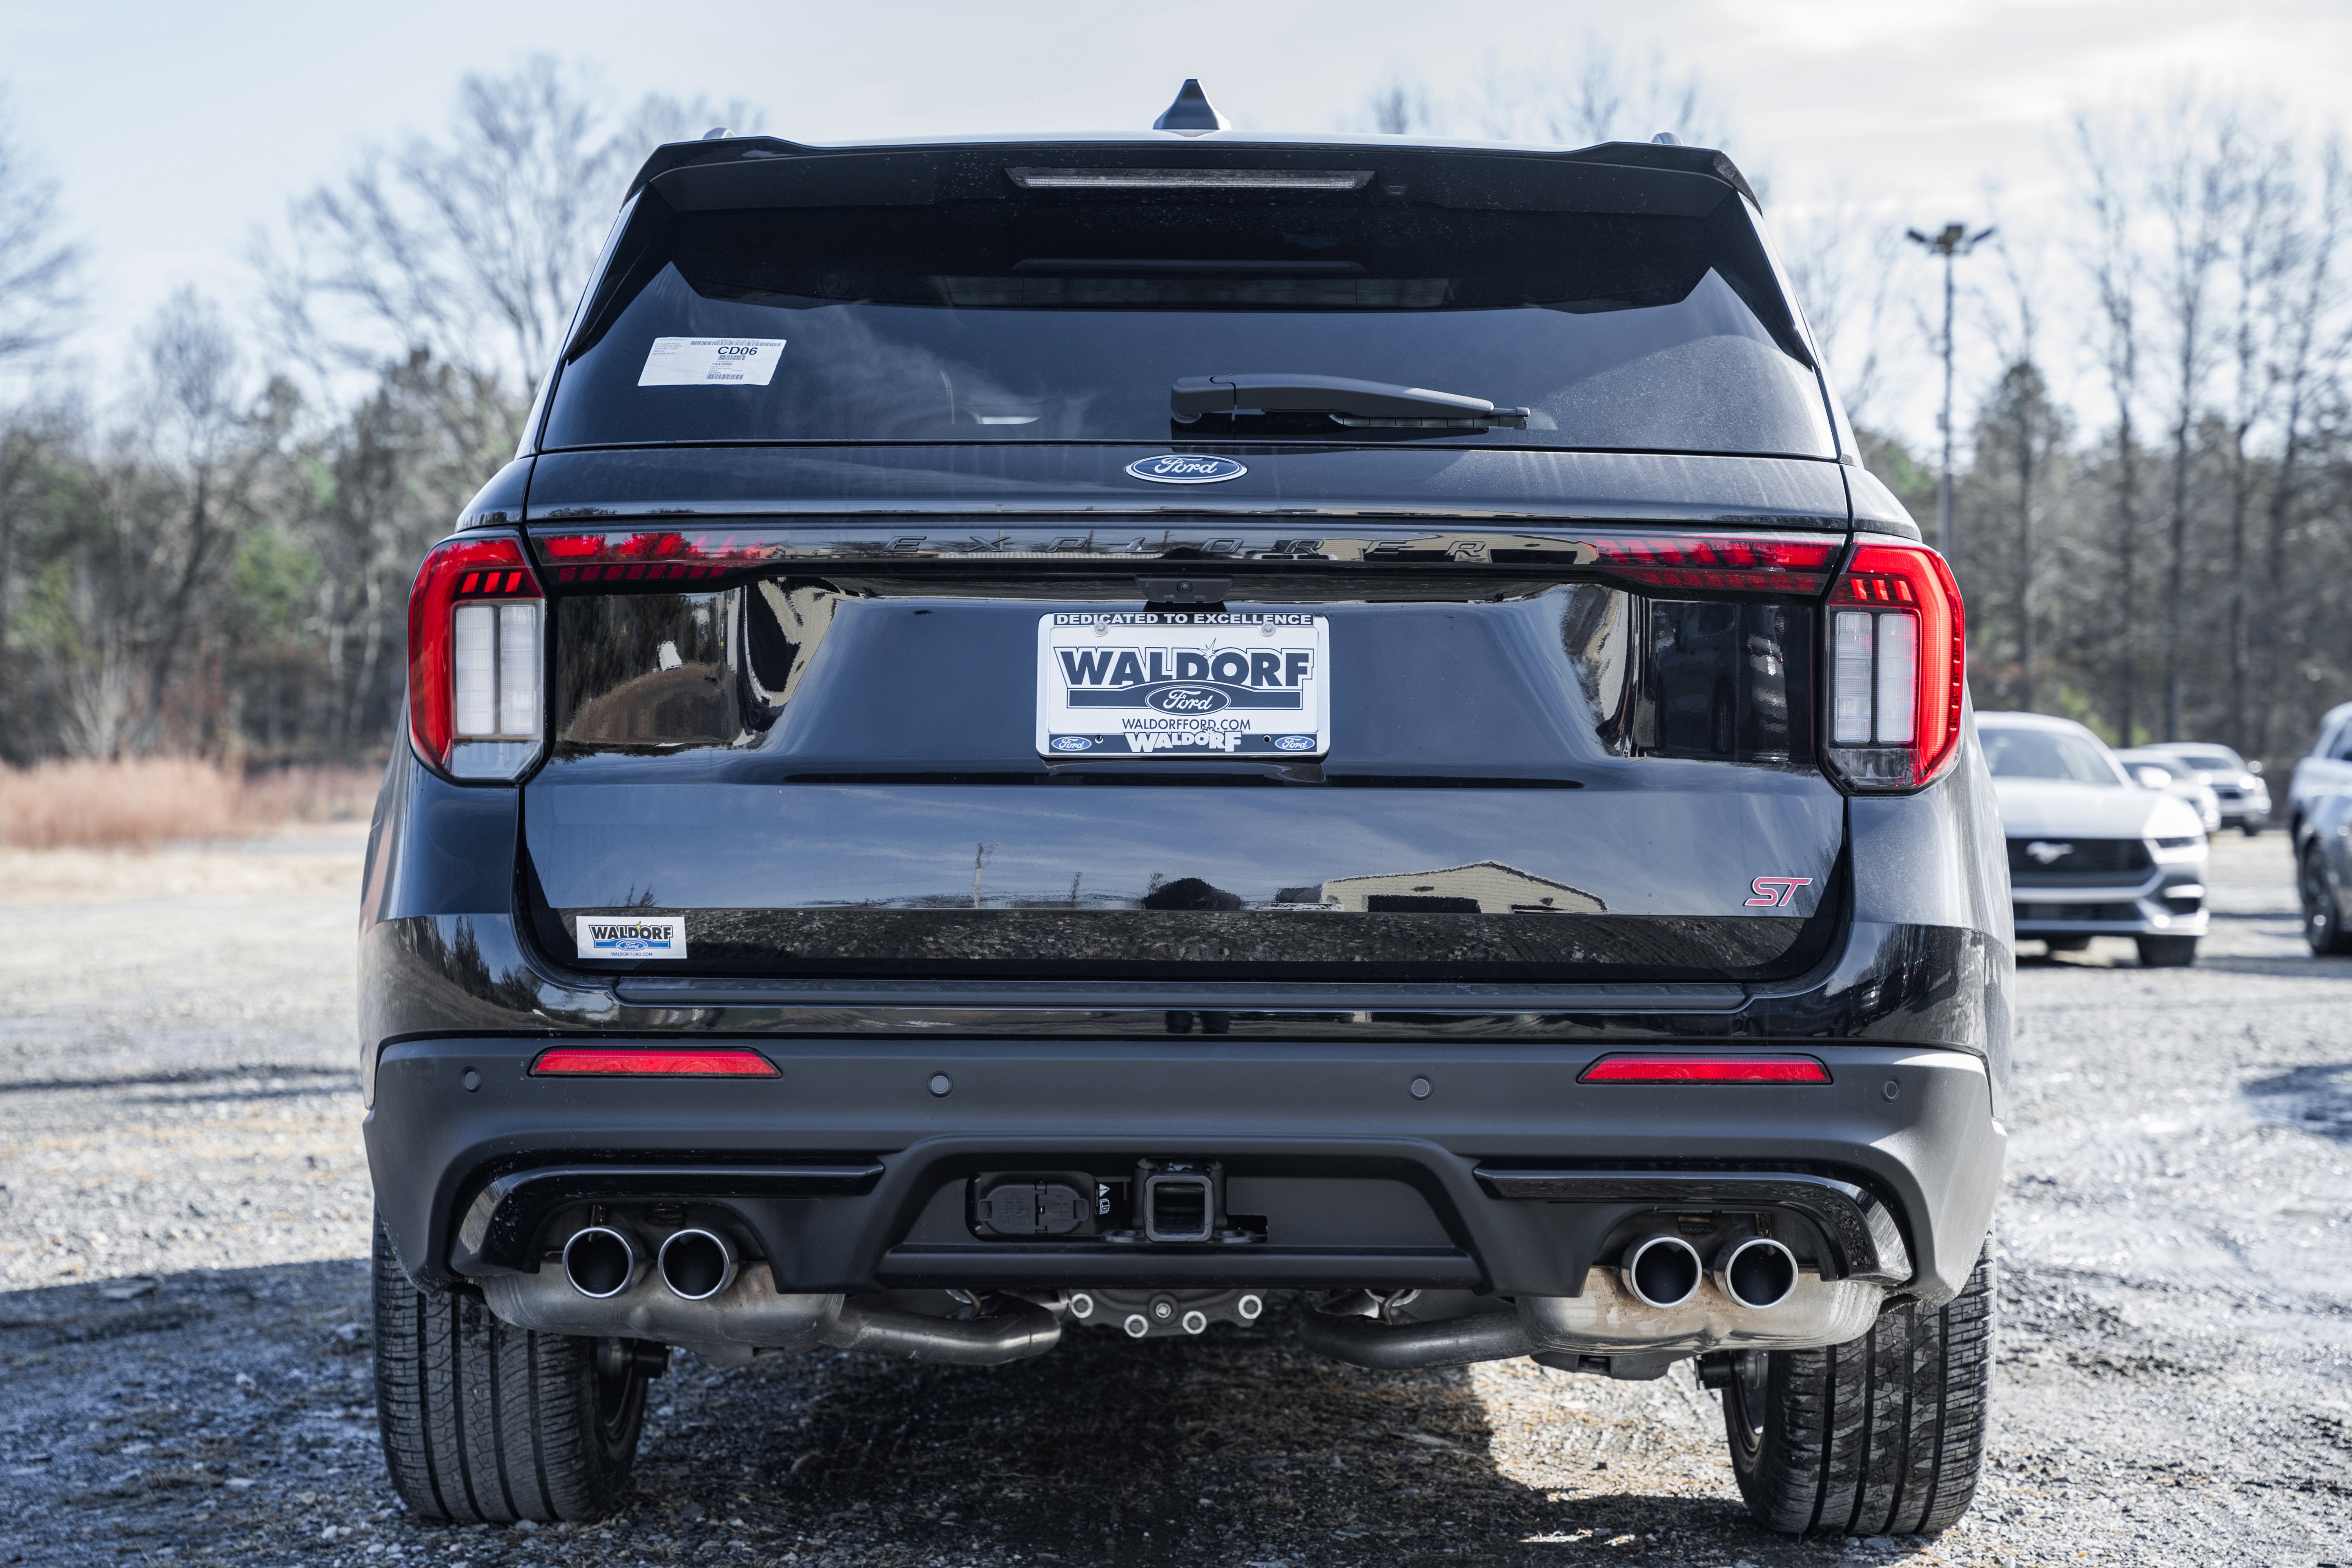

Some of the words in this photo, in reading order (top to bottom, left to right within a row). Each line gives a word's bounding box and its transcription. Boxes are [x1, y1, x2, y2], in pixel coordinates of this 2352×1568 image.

[718, 346, 758, 355] CD06
[1154, 457, 1219, 473] Ford
[883, 536, 1486, 557] EXPLORER
[1057, 614, 1158, 624] DEDICATED
[1163, 614, 1188, 624] TO
[1194, 614, 1311, 624] EXCELLENCE
[1061, 651, 1309, 686] WALDORF
[1163, 689, 1212, 710] Ford
[1122, 719, 1251, 730] WALDORFFORD.COM
[1058, 738, 1083, 749] Ford
[1125, 732, 1242, 752] WALDORF
[1282, 738, 1308, 749] Ford
[1744, 877, 1813, 907] ST
[591, 927, 671, 939] WALDORF
